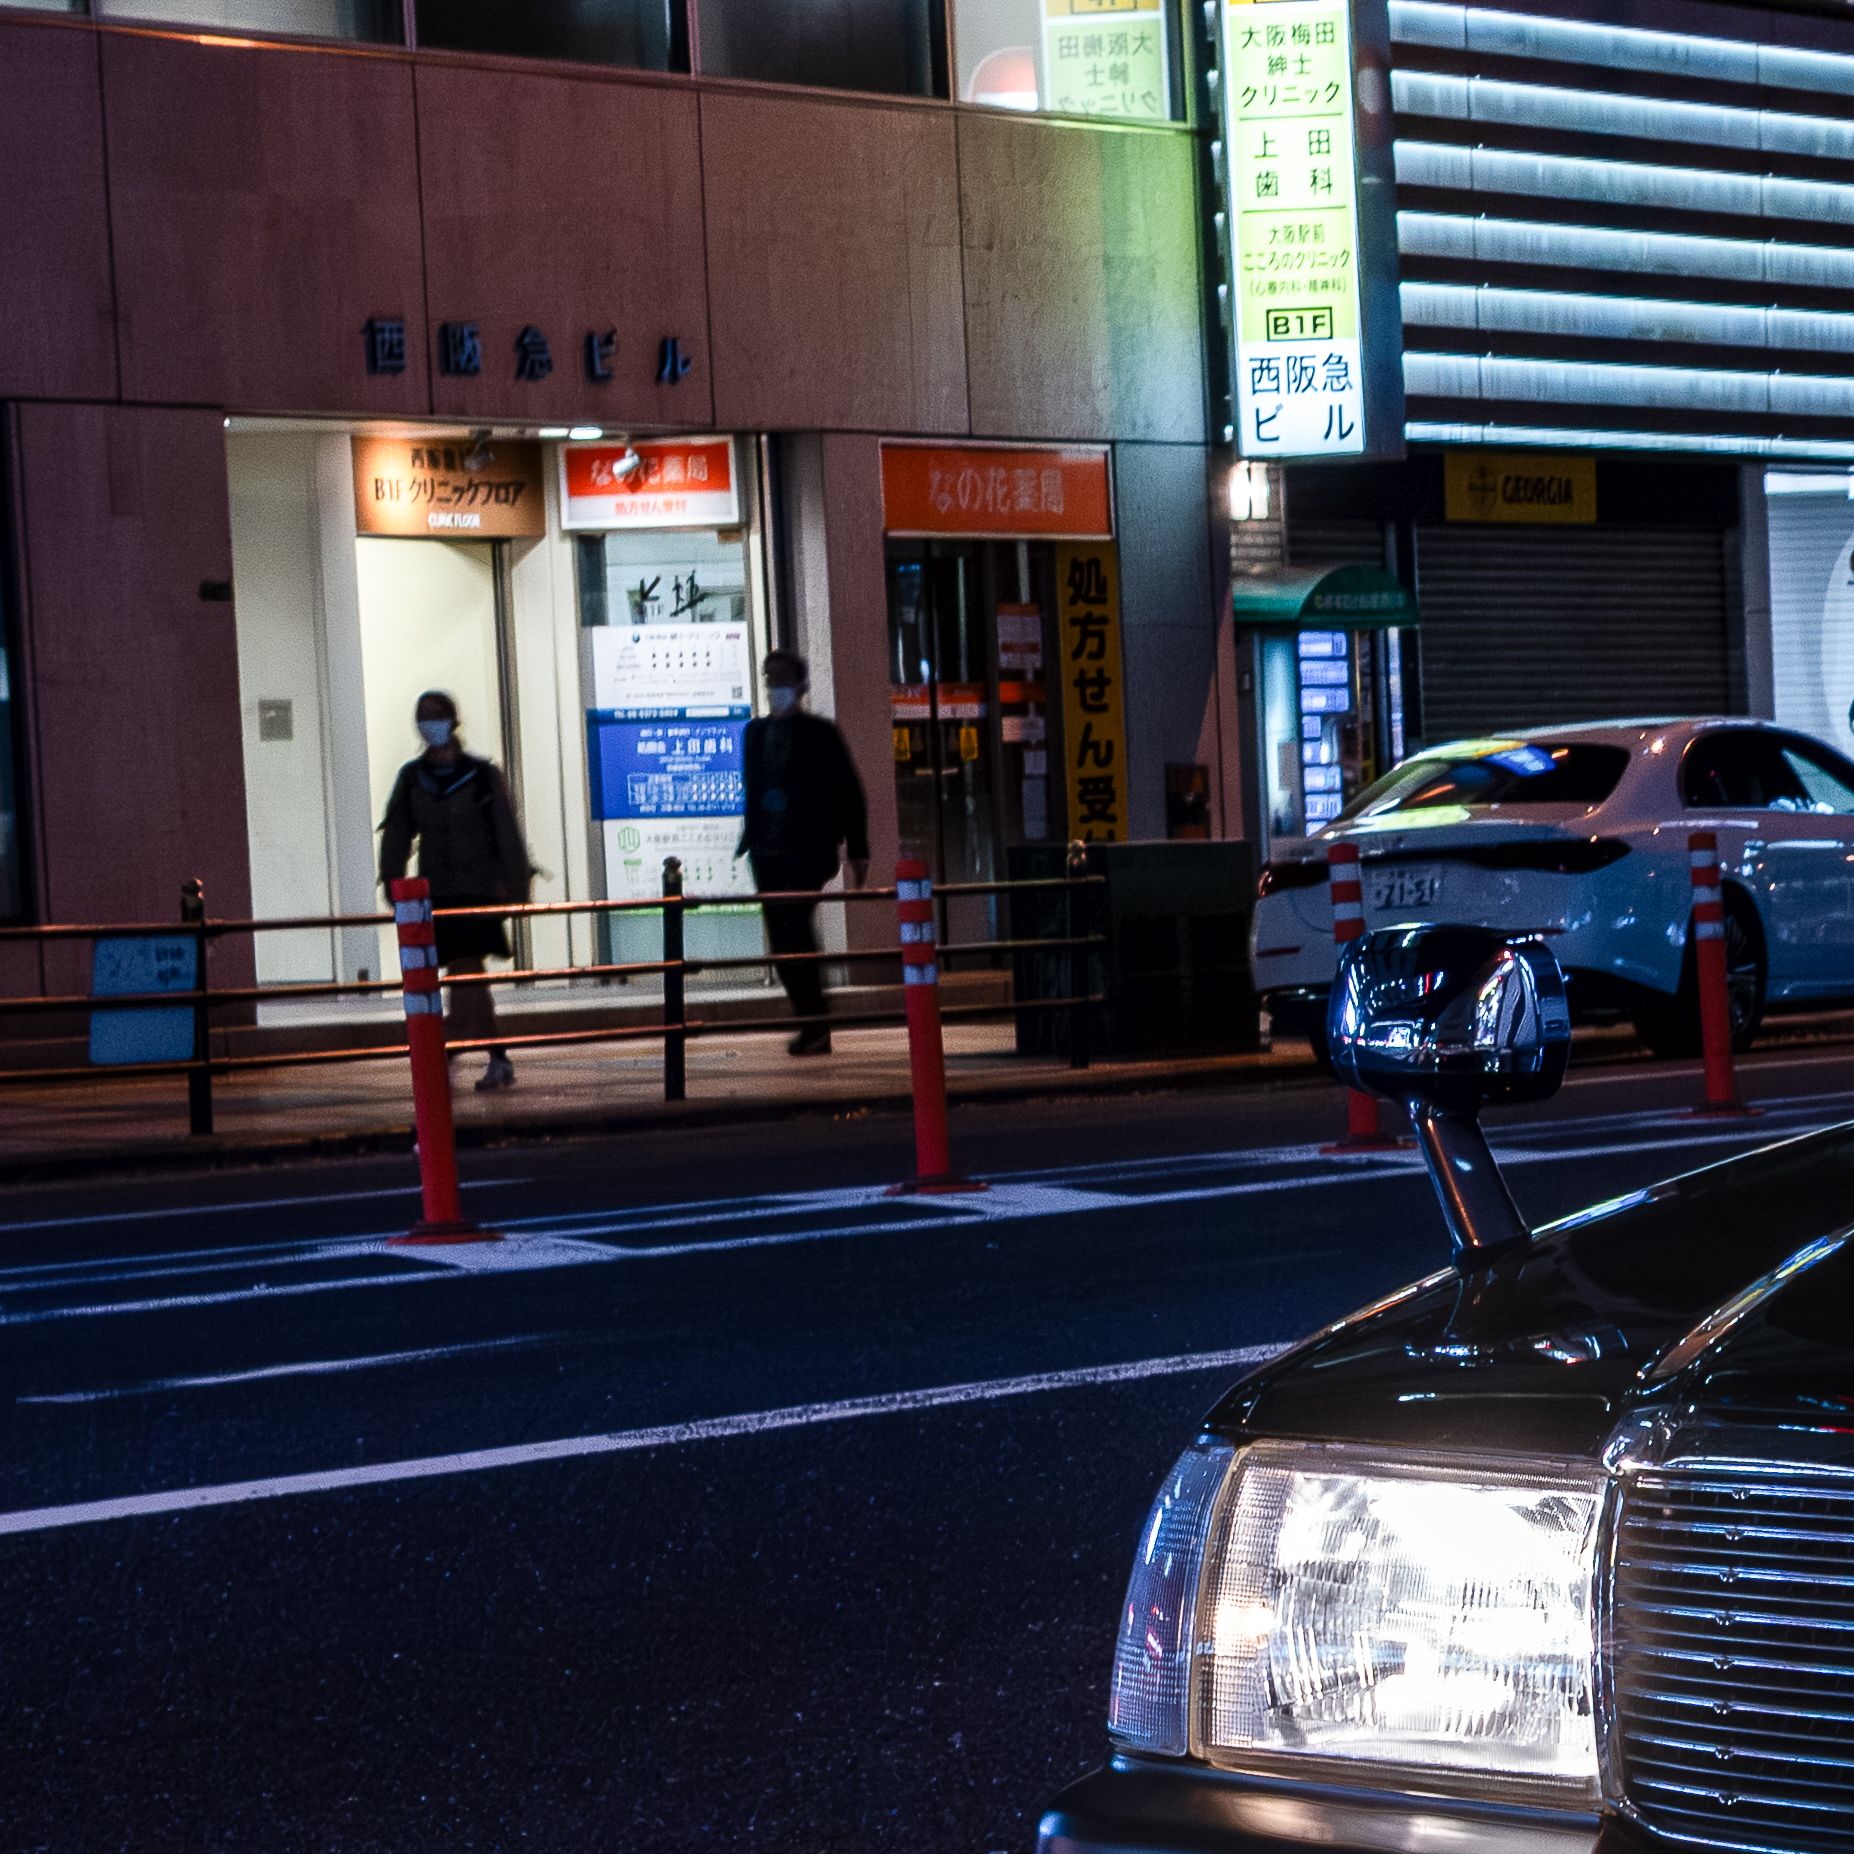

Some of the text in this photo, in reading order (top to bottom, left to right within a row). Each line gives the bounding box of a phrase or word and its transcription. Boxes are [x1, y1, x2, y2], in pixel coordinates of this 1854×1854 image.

[1241, 21, 1336, 50] 大阪梅田
[1267, 53, 1312, 76] 紳士
[1240, 81, 1342, 108] クリニック
[1254, 129, 1332, 160] 上田
[1255, 167, 1334, 199] 歯科
[1267, 223, 1325, 246] 大阪駅前
[1242, 247, 1350, 273] こころのクリニック
[1272, 313, 1329, 337] B1F
[1249, 352, 1354, 395] 西阪急
[1254, 404, 1356, 443] ビル
[591, 454, 708, 487] な花薬局
[408, 477, 527, 507] クリニックフロア
[928, 467, 1065, 517] なの花薬局
[1502, 475, 1574, 506] GEORGIA
[1067, 557, 1118, 842] 処方せん受
